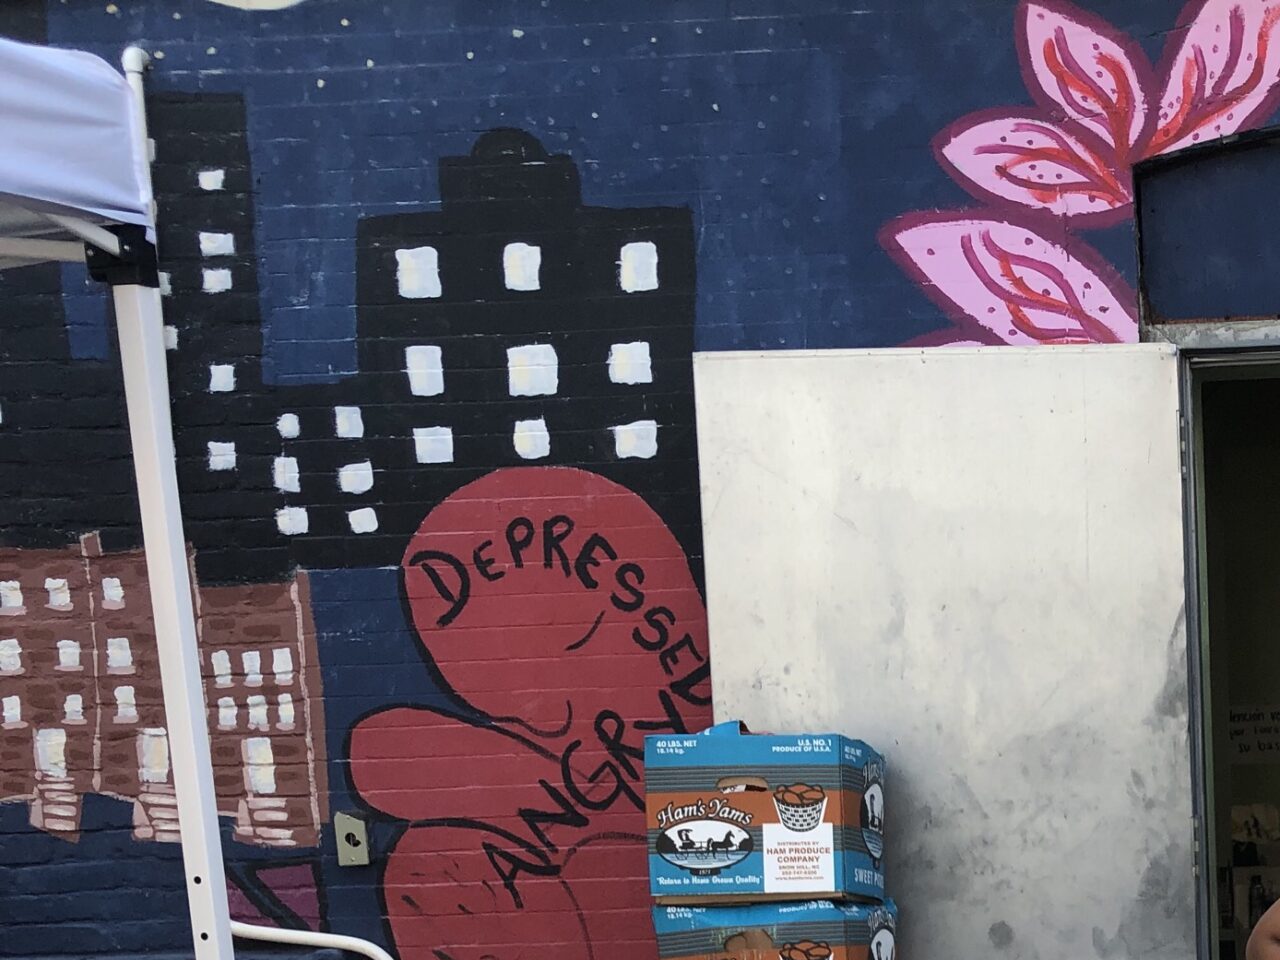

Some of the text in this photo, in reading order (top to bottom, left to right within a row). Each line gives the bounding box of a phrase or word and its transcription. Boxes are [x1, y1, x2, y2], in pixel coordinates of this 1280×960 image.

[409, 513, 713, 706] DEPRESSED
[482, 689, 690, 908] ANGRY
[657, 799, 753, 828] Ham's Yams
[777, 856, 820, 864] COMPANY
[854, 867, 873, 885] SWEET
